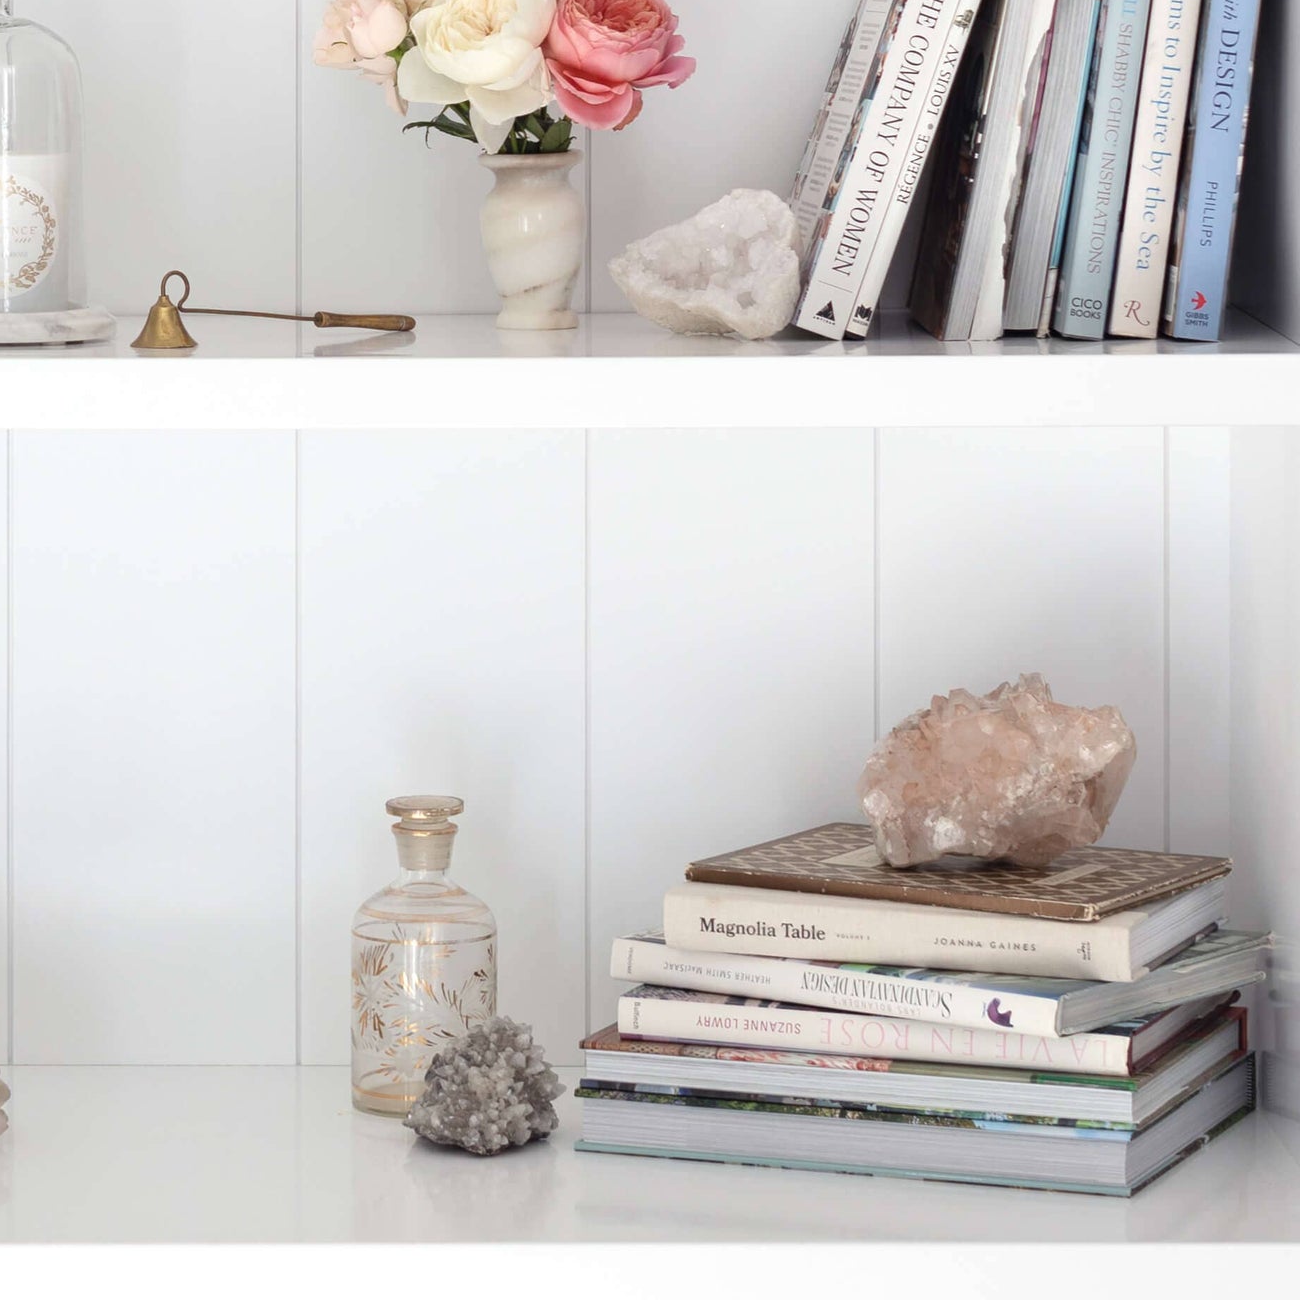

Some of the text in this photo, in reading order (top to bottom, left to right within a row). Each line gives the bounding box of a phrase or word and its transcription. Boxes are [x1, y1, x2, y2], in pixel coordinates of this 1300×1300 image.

[1111, 22, 1133, 94] SHABBY
[1164, 35, 1181, 58] to
[876, 34, 930, 147] COMPANY
[1210, 29, 1240, 133] DESIGN
[1151, 67, 1181, 143] Inspire
[897, 44, 959, 205] RÉGENCE LOUIS XV
[866, 151, 890, 184] OF
[1142, 153, 1172, 177] by
[1087, 152, 1117, 274] INSPIRATIONS
[1142, 185, 1166, 223] the
[1200, 181, 1219, 247] PHILLIPS
[831, 188, 879, 276] WOMEN
[1136, 231, 1160, 270] Sea
[1070, 308, 1101, 320] BOOKS
[1071, 297, 1102, 310] CICO
[1124, 300, 1150, 327] R
[1185, 311, 1209, 320] GIBBS
[1185, 318, 1208, 327] SMITH
[699, 917, 826, 941] Magnolia Table
[934, 937, 1037, 952] JOANNA GAINES
[706, 968, 731, 980] SMITH
[734, 971, 771, 985] HEATHER
[800, 971, 849, 996] DESIGN
[696, 1015, 801, 1034] SUZANNE LOWRY
[820, 1018, 1108, 1066] LA VIE EN ROSE
